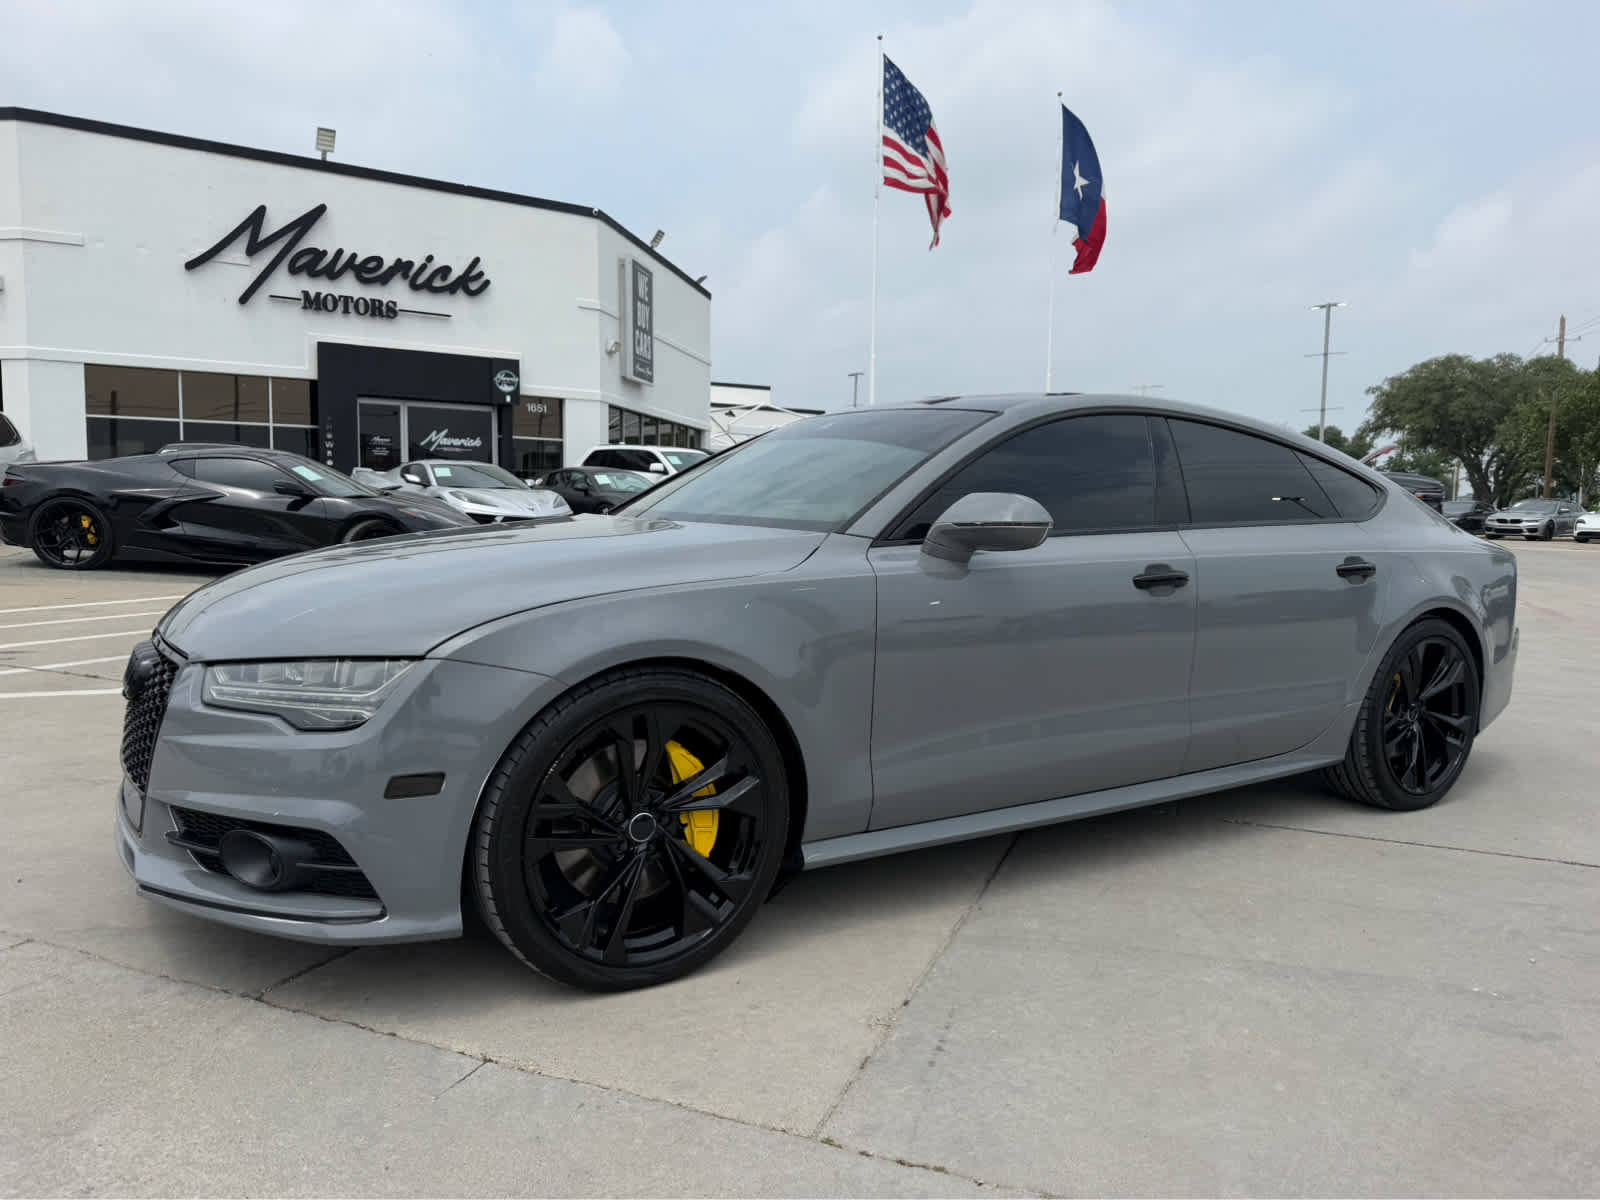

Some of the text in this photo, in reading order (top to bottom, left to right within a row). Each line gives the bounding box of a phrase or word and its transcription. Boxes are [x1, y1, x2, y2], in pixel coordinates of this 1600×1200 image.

[185, 203, 491, 305] Maverick
[301, 290, 399, 319] MOTORS
[525, 402, 548, 415] 1651
[419, 428, 483, 452] Maverick
